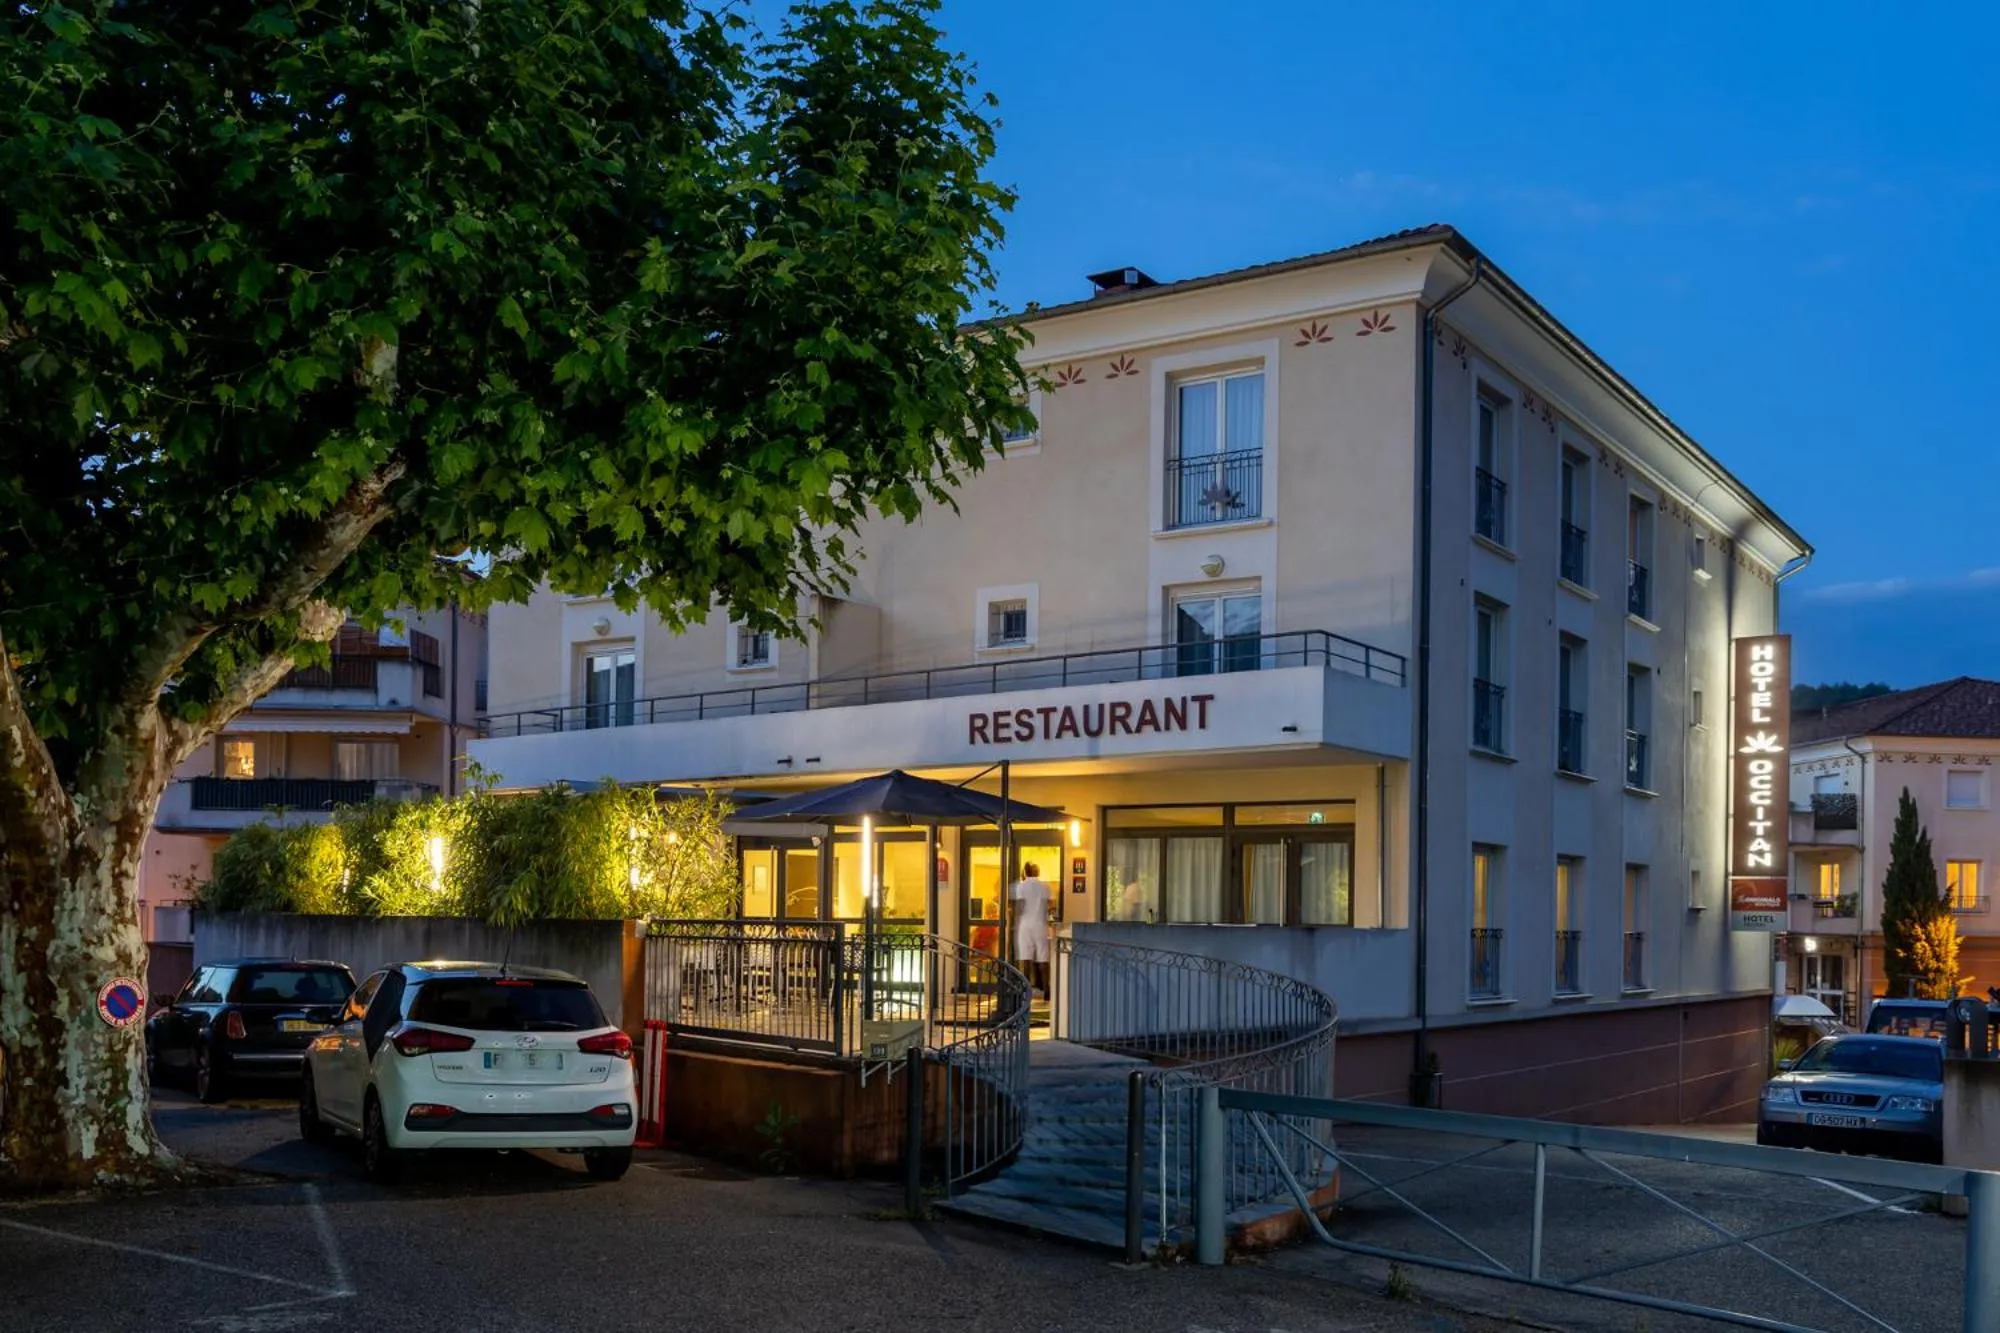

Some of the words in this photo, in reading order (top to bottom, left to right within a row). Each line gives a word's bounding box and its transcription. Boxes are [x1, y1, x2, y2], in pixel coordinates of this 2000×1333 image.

[1750, 643, 1774, 723] HOTEL
[968, 694, 1216, 745] RESTAURANT
[1747, 759, 1774, 868] OCCITAN
[1743, 914, 1776, 923] HOTEL
